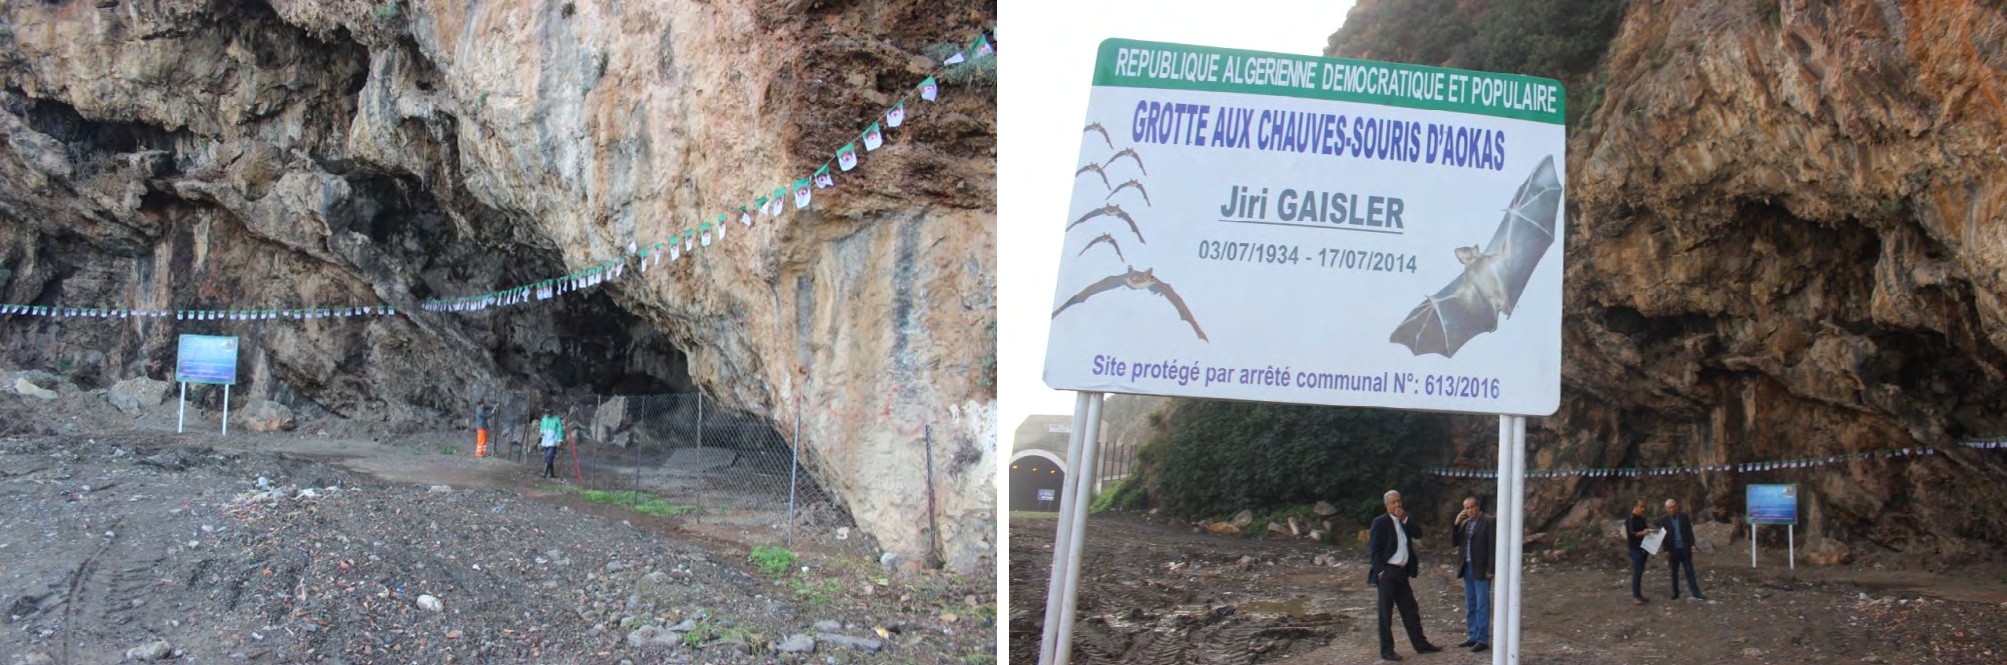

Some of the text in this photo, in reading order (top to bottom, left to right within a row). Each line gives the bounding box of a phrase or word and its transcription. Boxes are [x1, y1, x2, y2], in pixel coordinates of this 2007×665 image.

[1115, 48, 1557, 113] REPUBLIQUE ALGERIENNE DEMOCRATIQUE ET POPULAIRE
[1132, 100, 1505, 171] GROTTE AUX CHAUVES-SOURIS D'AOKAS
[1220, 185, 1404, 228] Jiri GAISLER
[1199, 240, 1299, 265] 03/07/1934
[1318, 248, 1417, 274] 17/07/2014
[1092, 355, 1126, 376] Site
[1131, 359, 1200, 386] protégé
[1205, 366, 1235, 387] par
[1239, 365, 1290, 386] arrêté
[1296, 370, 1387, 393] communal
[1425, 374, 1500, 399] 613/2016
